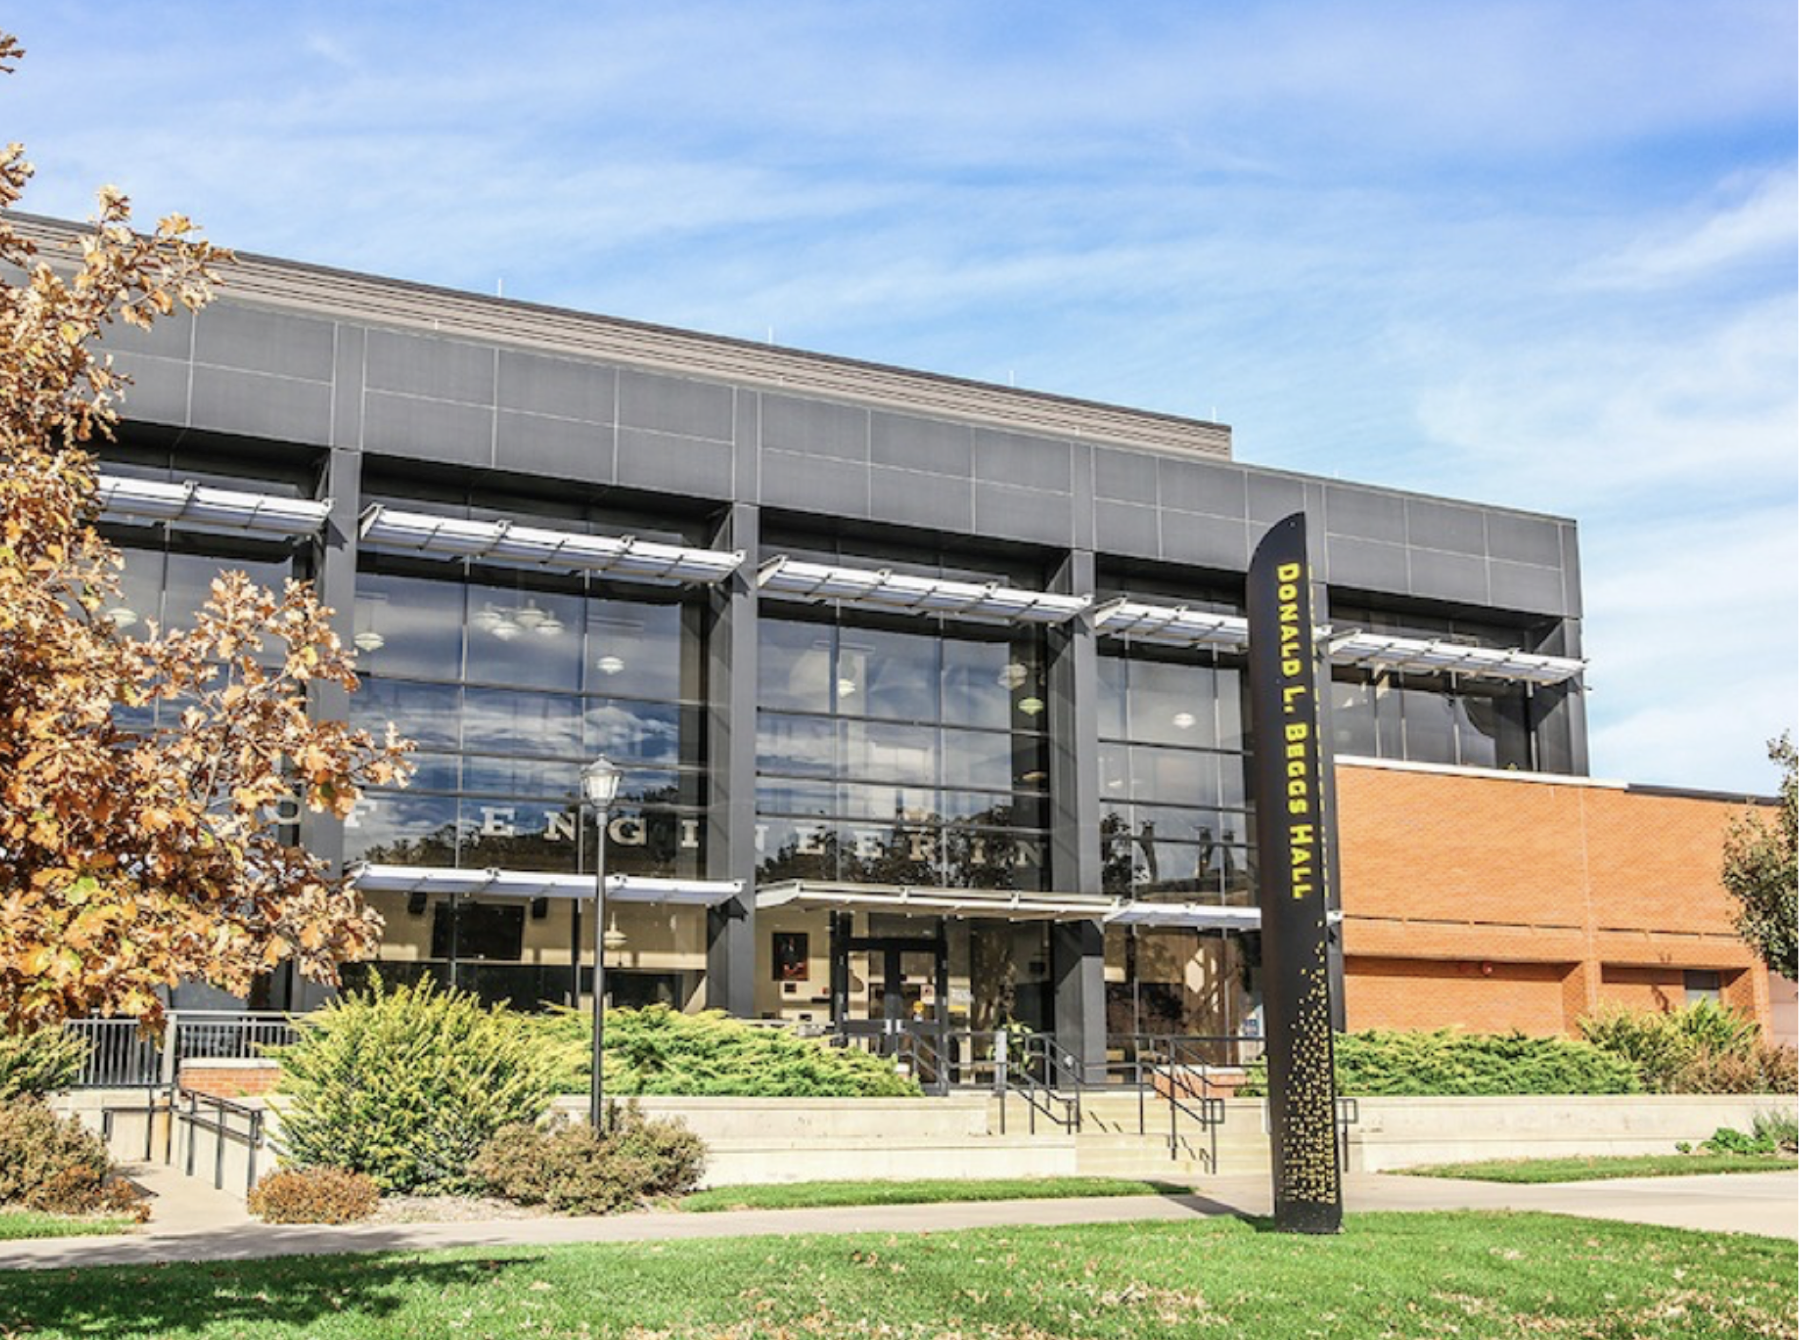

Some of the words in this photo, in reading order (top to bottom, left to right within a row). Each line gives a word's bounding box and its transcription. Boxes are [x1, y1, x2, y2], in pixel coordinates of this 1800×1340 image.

[1278, 562, 1302, 677] DONALD
[1283, 685, 1306, 713] L.
[1285, 722, 1309, 815] BEGGS
[1289, 824, 1315, 899] HALL
